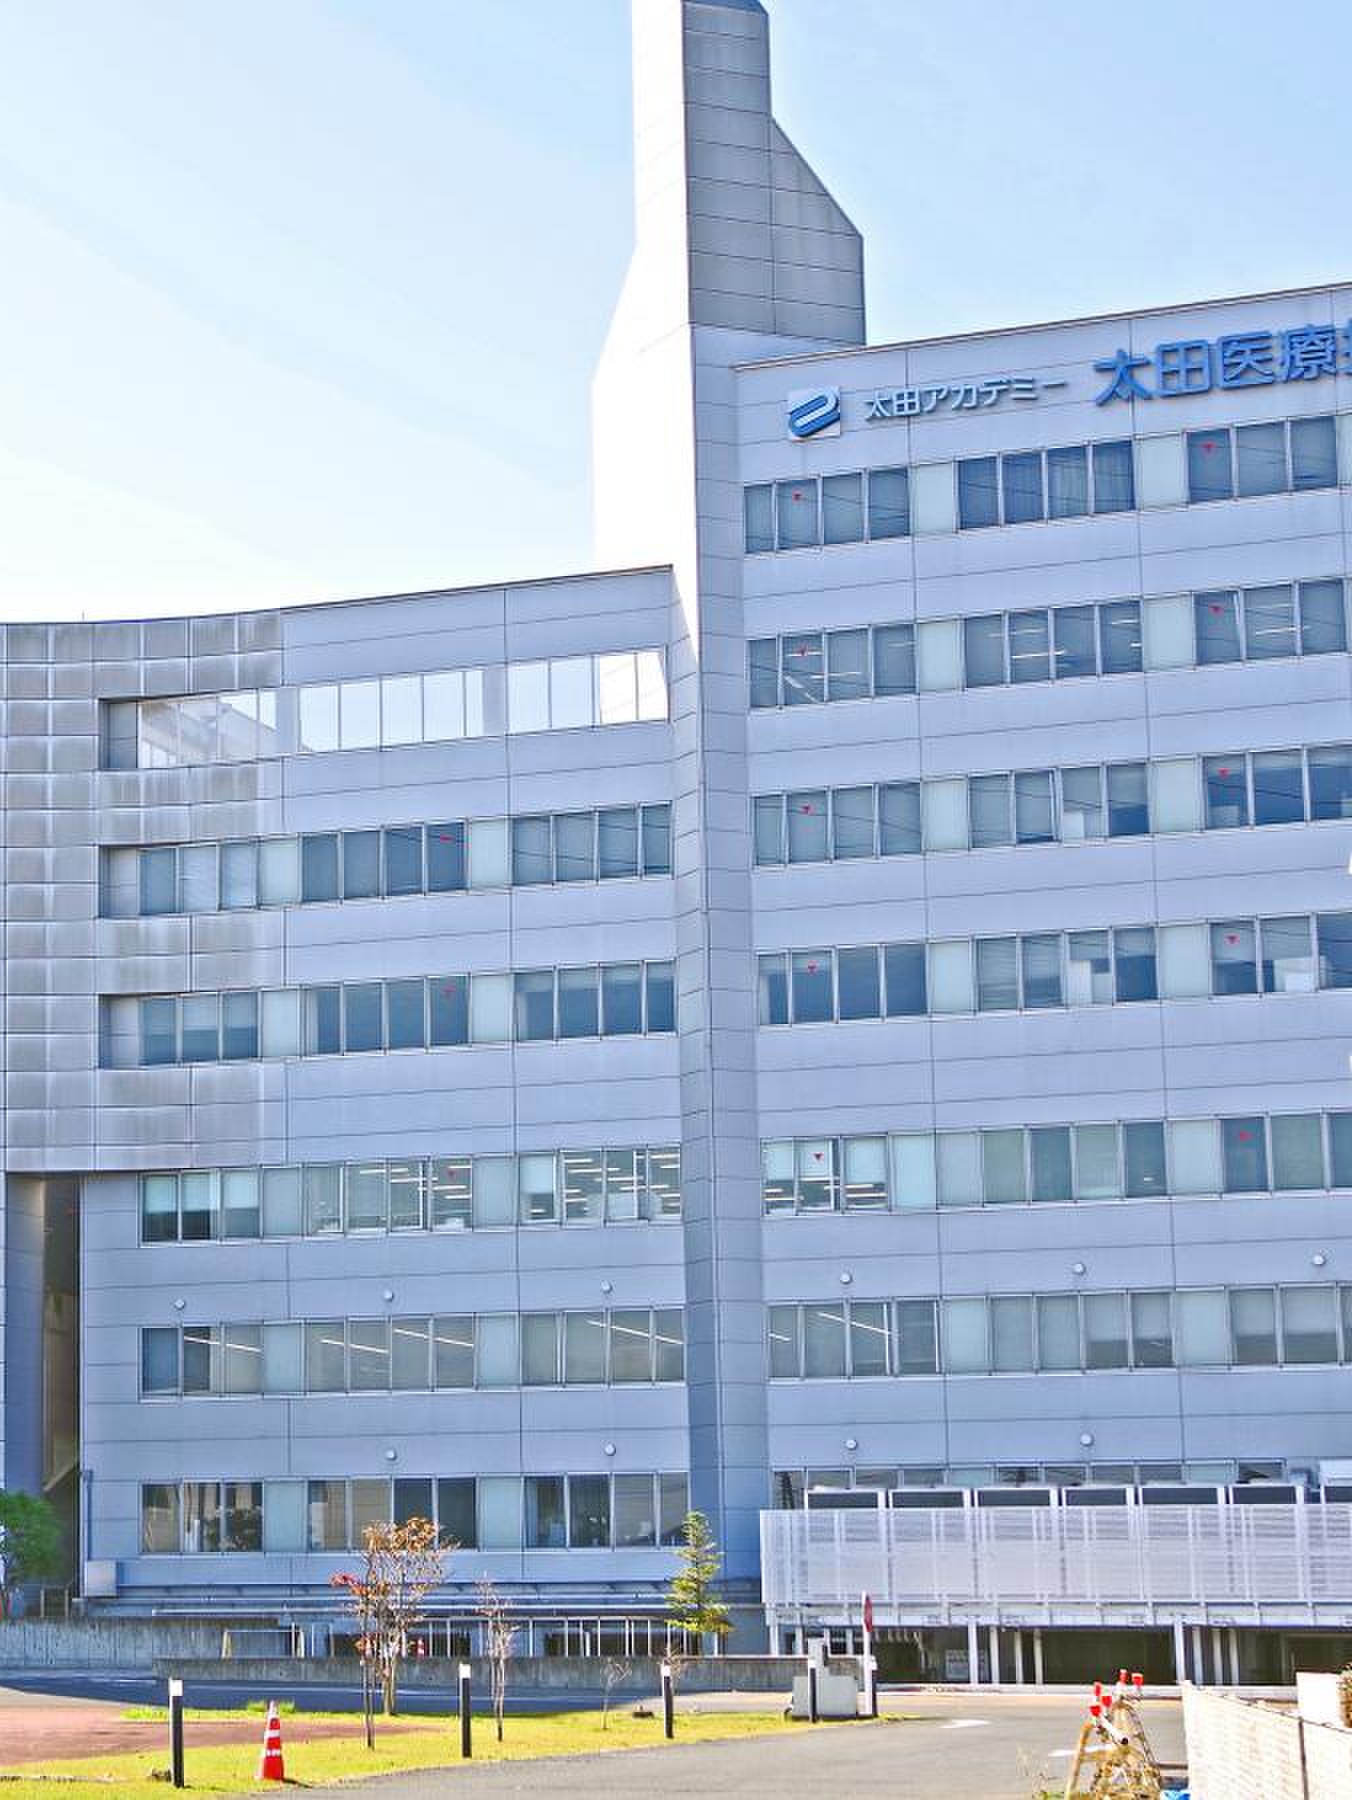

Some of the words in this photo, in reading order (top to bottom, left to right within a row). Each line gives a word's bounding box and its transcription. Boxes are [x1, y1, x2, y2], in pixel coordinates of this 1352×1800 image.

[864, 377, 1067, 421] 太田アカデミー
[1093, 318, 1352, 407] 太田医療
